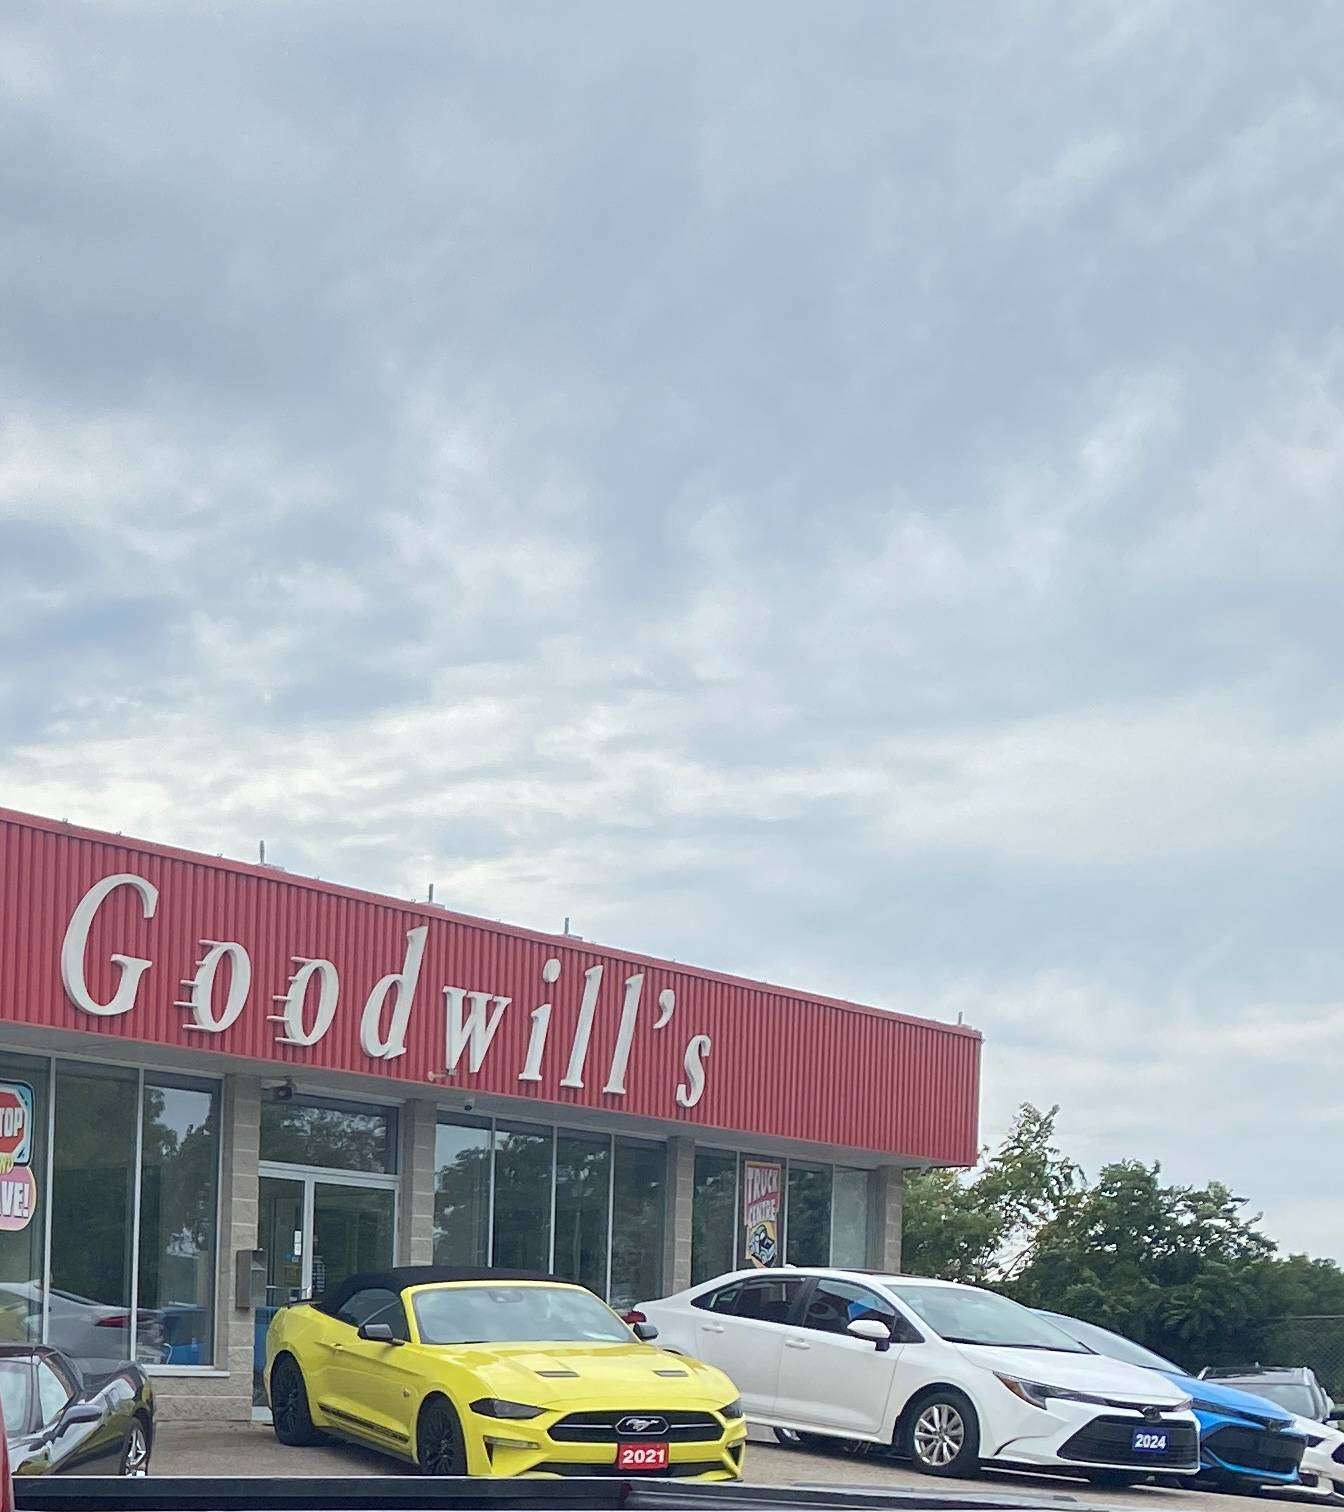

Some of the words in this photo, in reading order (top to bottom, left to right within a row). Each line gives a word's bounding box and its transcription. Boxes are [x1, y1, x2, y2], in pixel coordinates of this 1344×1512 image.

[60, 872, 713, 1109] Goodwill's
[1134, 1433, 1167, 1450] 2024
[622, 1449, 665, 1465] 2021
